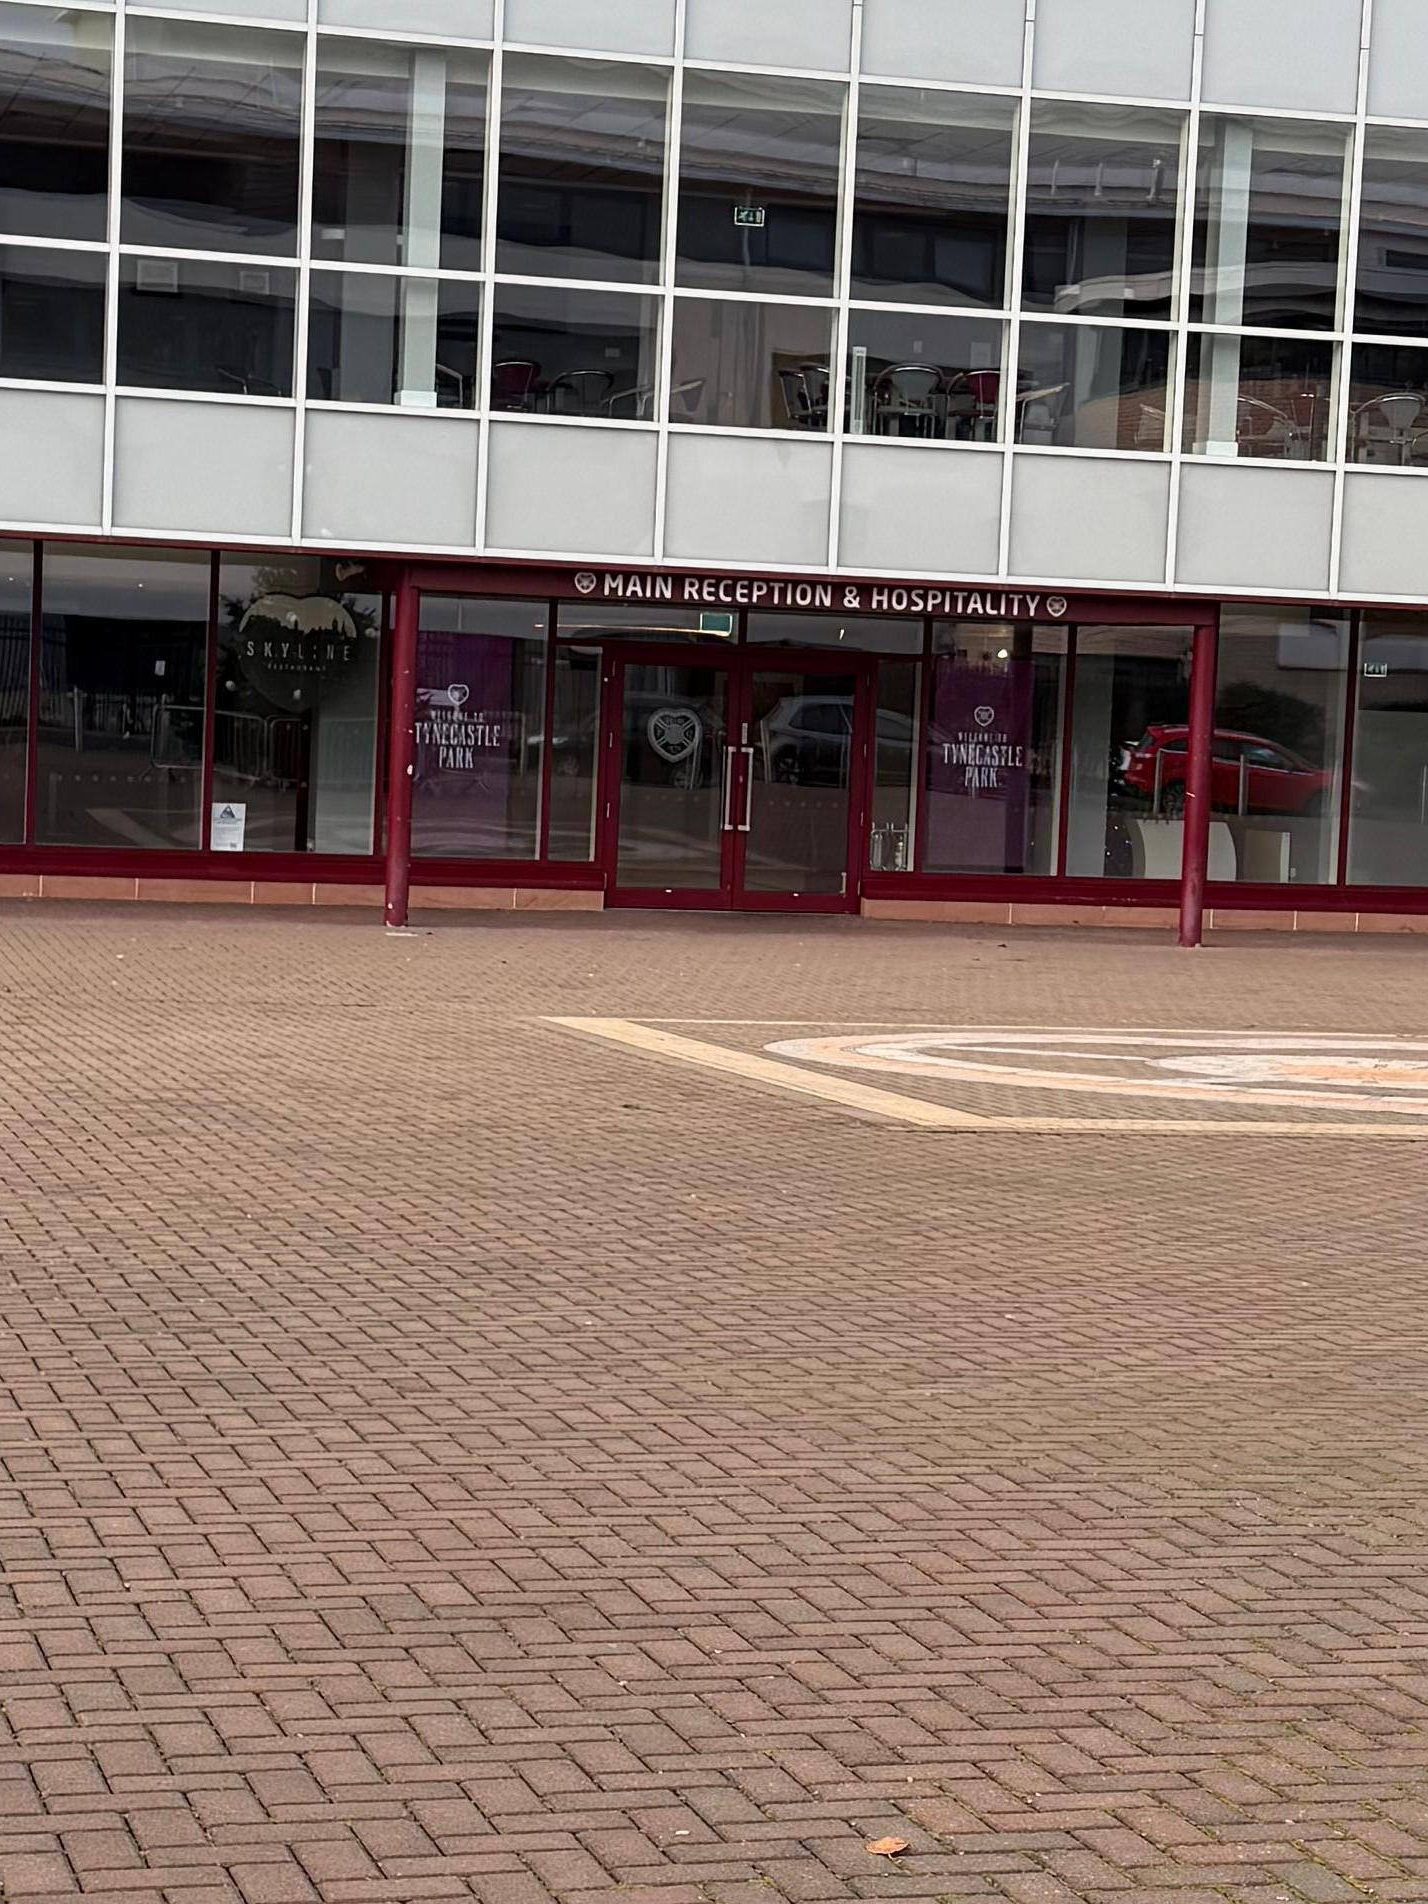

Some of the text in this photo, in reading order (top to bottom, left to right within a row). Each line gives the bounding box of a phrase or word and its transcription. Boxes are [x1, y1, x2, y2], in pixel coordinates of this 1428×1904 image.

[603, 573, 1041, 617] MAIN RECEPTION & HOSPITALITY
[246, 640, 351, 661] SKYLINE
[414, 722, 501, 747] TYNECASTLE
[438, 746, 474, 769] PARK
[942, 743, 1023, 767] TYNECASTLE
[964, 766, 998, 788] PARK
